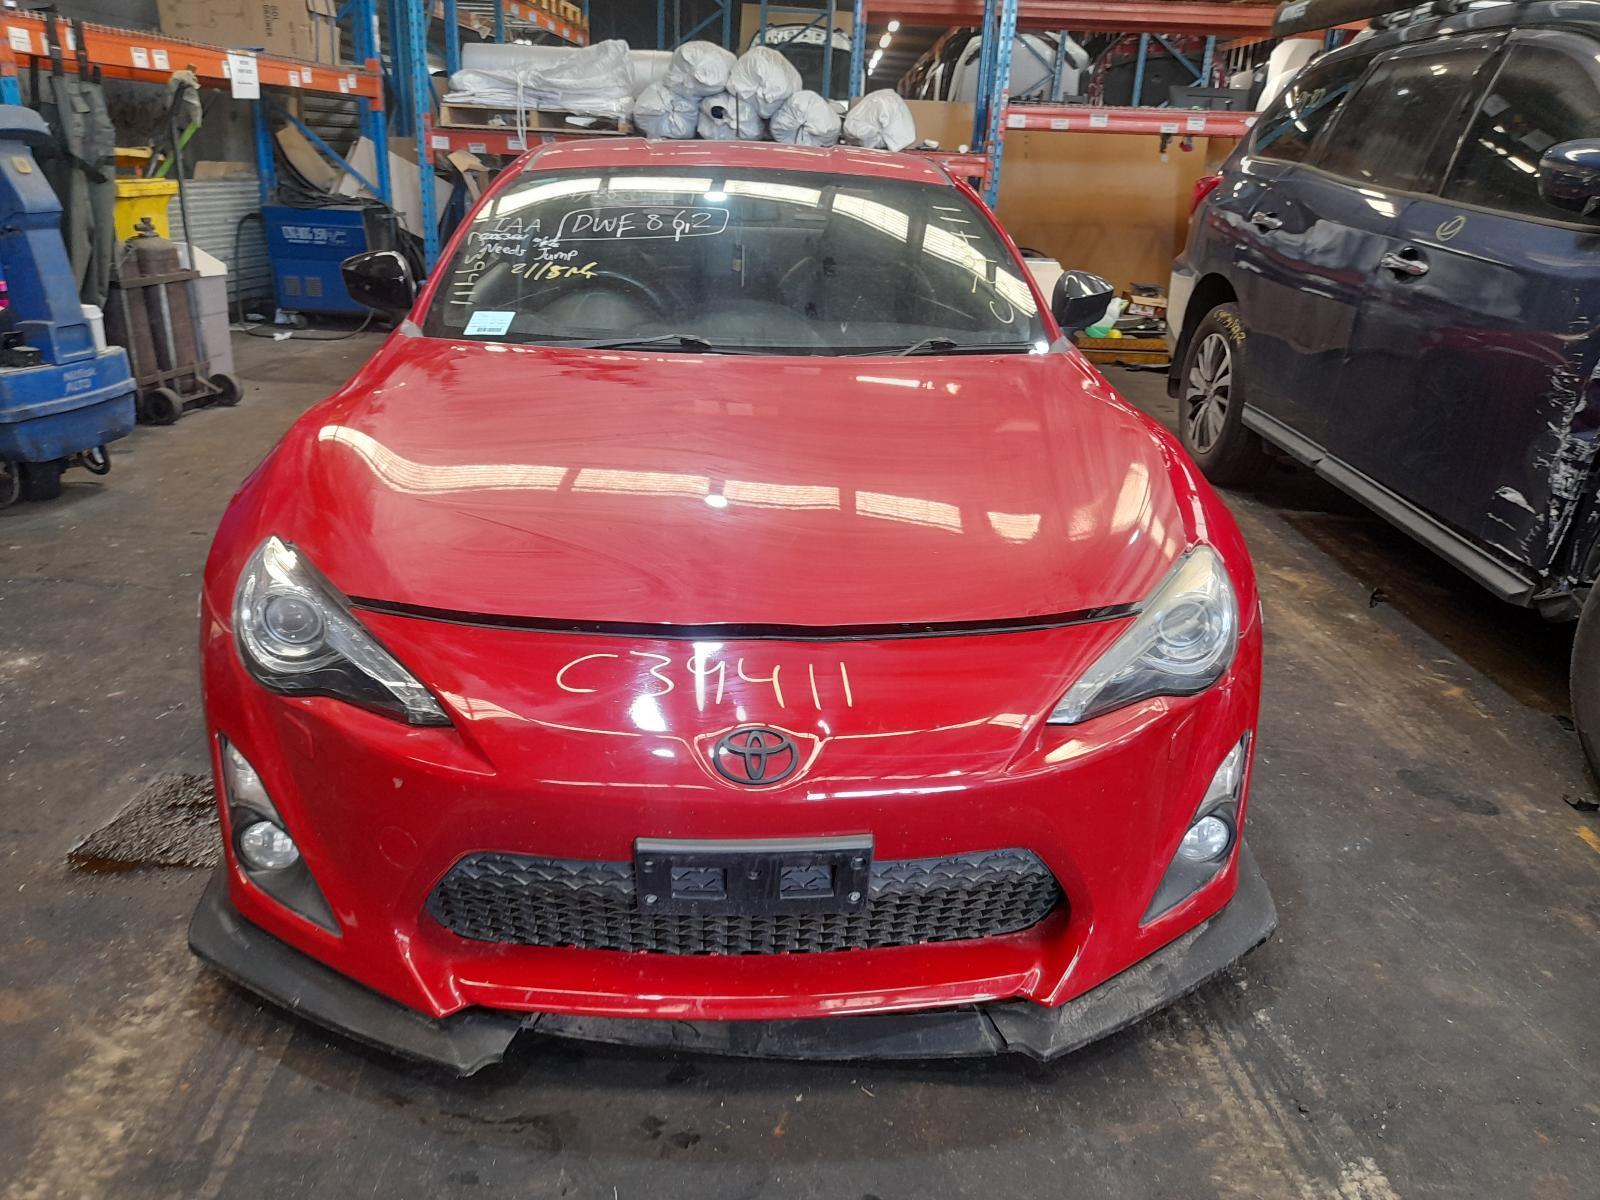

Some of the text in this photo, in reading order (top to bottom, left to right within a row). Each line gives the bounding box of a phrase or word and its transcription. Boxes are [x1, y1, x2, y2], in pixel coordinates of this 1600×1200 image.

[571, 212, 636, 238] DWF
[479, 243, 527, 257] Needs
[556, 650, 853, 711] C39411
